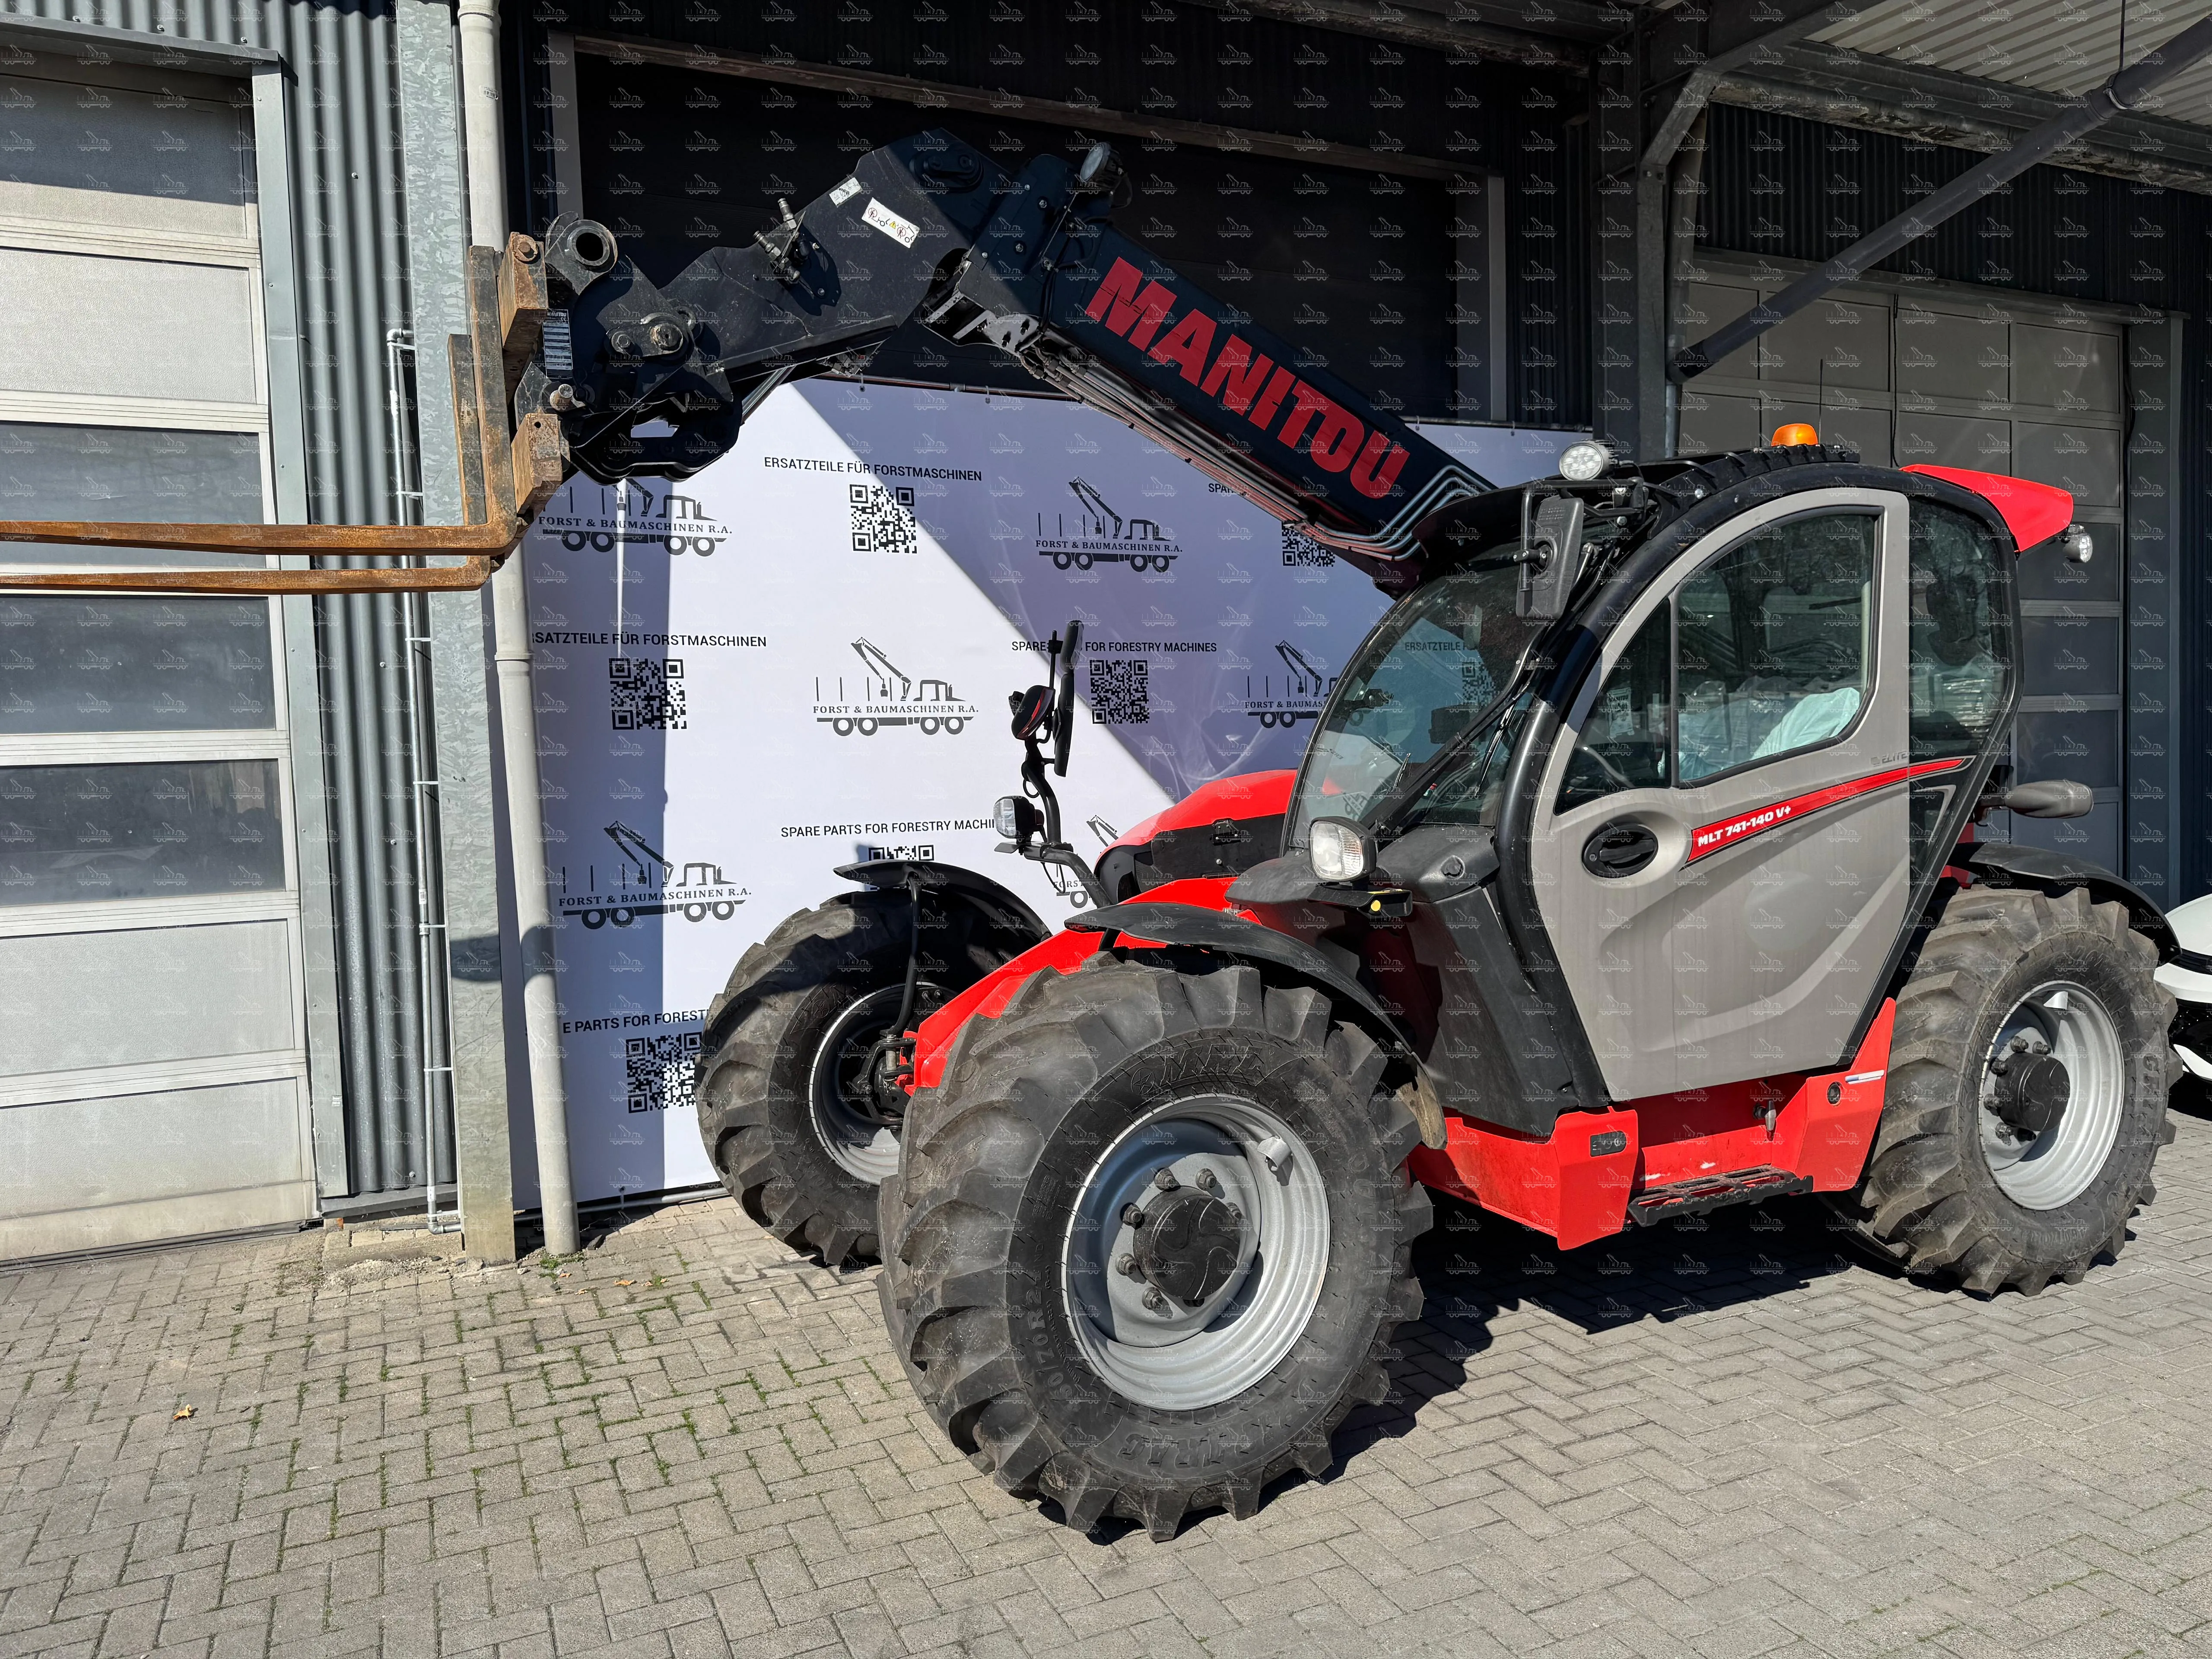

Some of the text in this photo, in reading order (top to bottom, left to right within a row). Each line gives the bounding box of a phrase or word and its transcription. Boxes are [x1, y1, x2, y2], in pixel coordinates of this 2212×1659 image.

[1085, 257, 1410, 499] MANITOU
[764, 457, 982, 481] ERSATZTEILE FÜR FORSTMASCHINEN
[539, 517, 581, 527] FORST
[601, 520, 705, 533] BAUMASCHINEN
[708, 525, 733, 534] R.A.
[1036, 540, 1068, 548] FORST
[1082, 542, 1160, 551] BAUMASCHINEN
[612, 631, 639, 645] FÜR
[644, 634, 766, 647] FORSTMASCHINEN
[1011, 641, 1046, 651] SPARE
[1085, 642, 1106, 652] FOR
[1109, 642, 1161, 652] FORESTRY
[1164, 642, 1217, 652] MACHINES
[1405, 642, 1460, 651] ERSATZTEILE
[866, 705, 954, 713] BAUMASCHINEN
[781, 819, 995, 837] SPARE PARTS FOR FORESTRY MACHI
[1698, 805, 1791, 847] MLT 741-140 V+
[559, 896, 602, 906] FORST
[621, 889, 723, 903] BAUMASCHINEN
[728, 888, 751, 896] R.A.
[575, 1017, 620, 1033] PARTS
[623, 1015, 650, 1027] FOR
[655, 1008, 709, 1025] FOREST
